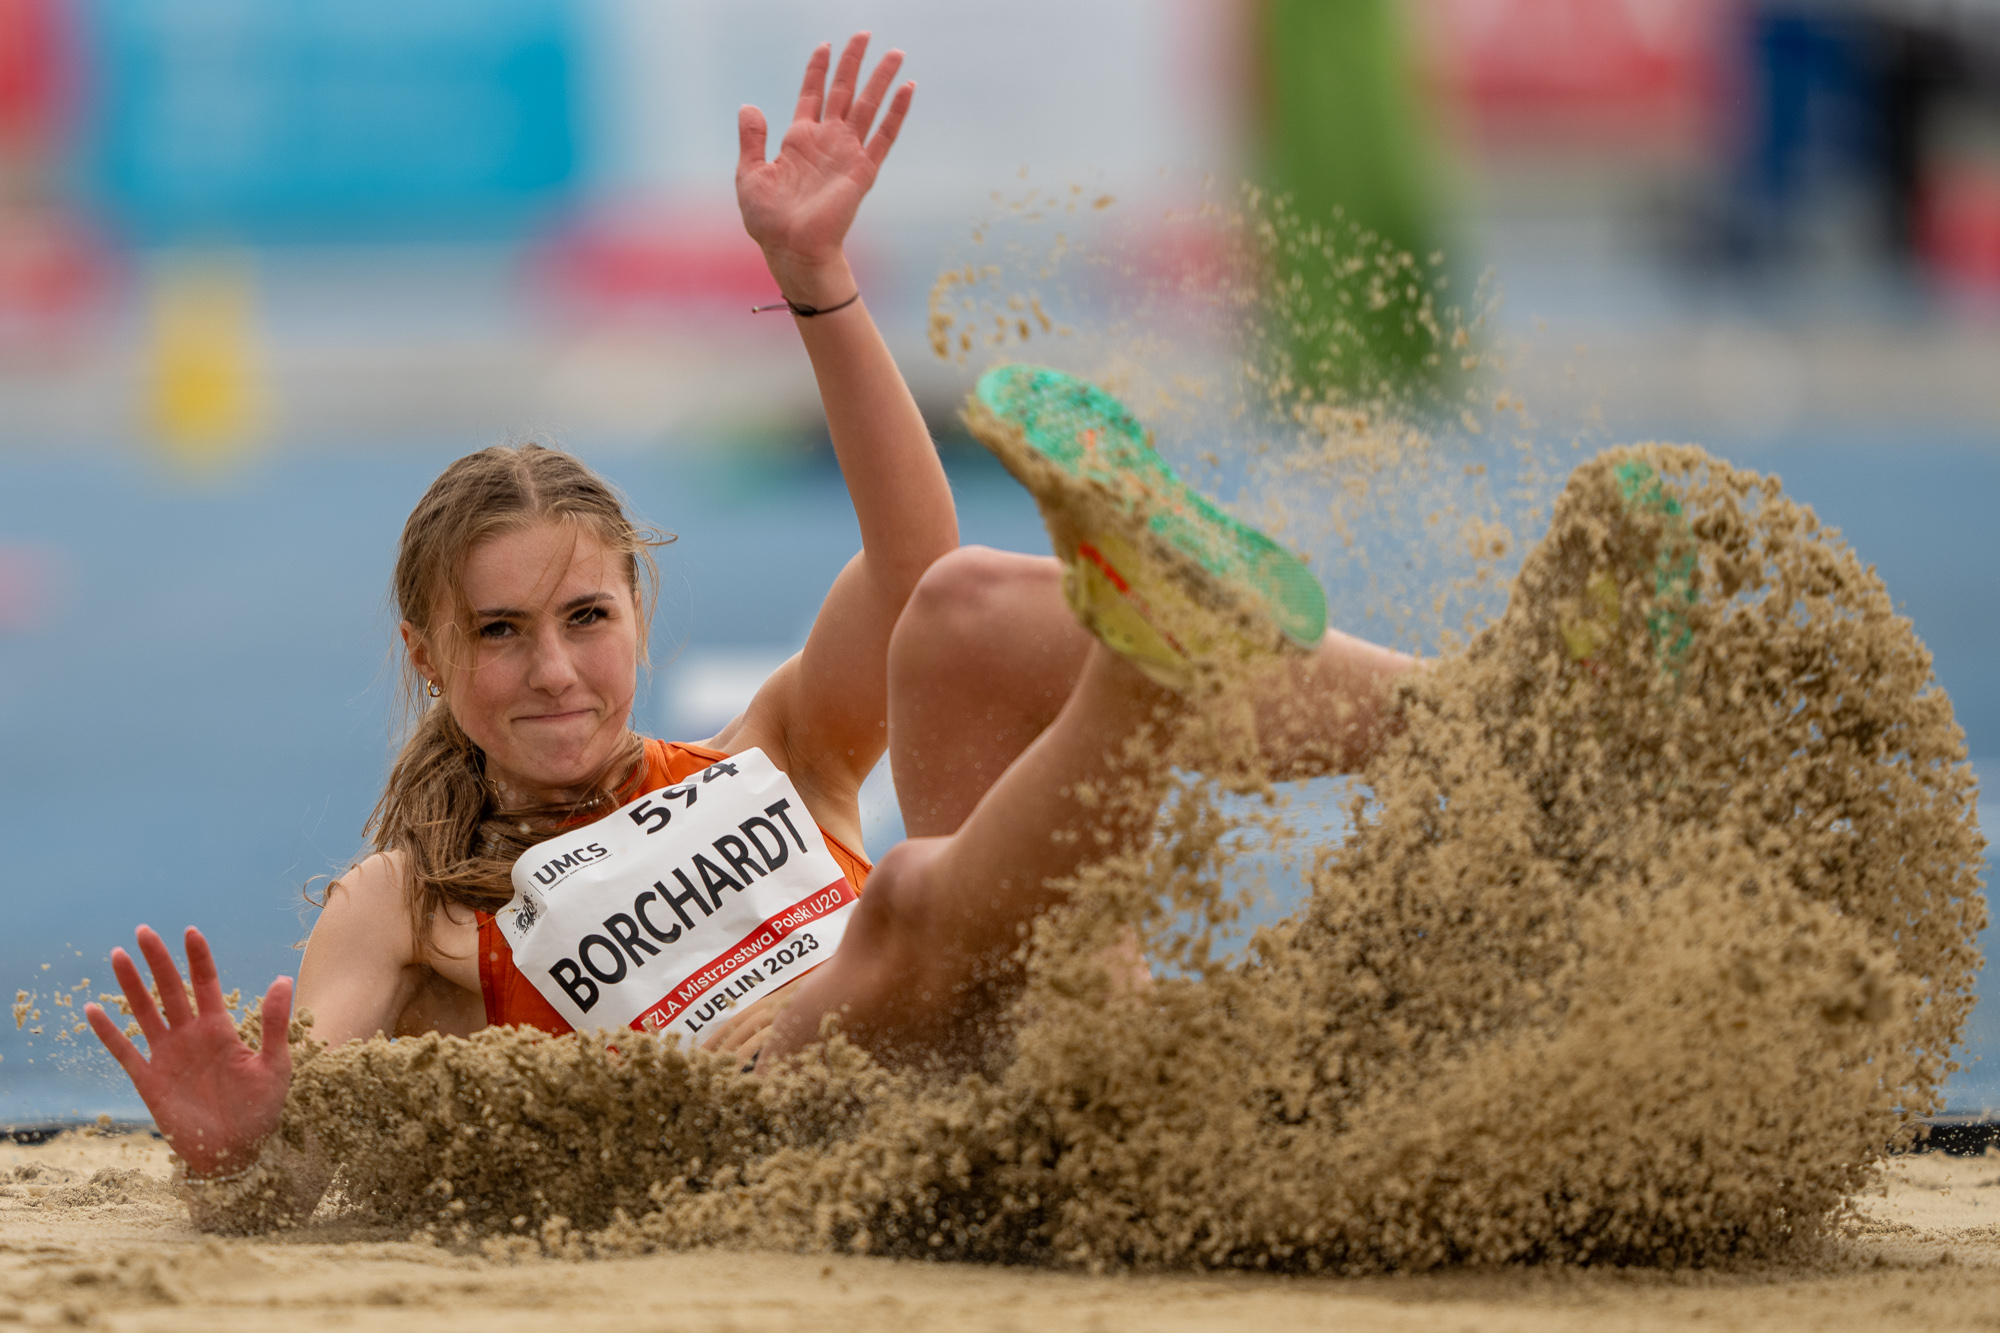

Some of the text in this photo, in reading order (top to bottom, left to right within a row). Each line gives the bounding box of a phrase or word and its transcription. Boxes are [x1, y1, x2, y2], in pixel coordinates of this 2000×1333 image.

[628, 762, 740, 836] 594
[532, 842, 608, 885] UMCS
[548, 797, 808, 1015] BORCHARDT
[678, 930, 775, 1002] Mistrzostwa
[771, 904, 814, 935] Polski
[810, 888, 842, 914] U20
[684, 933, 819, 1034] LUBLIN 2023
